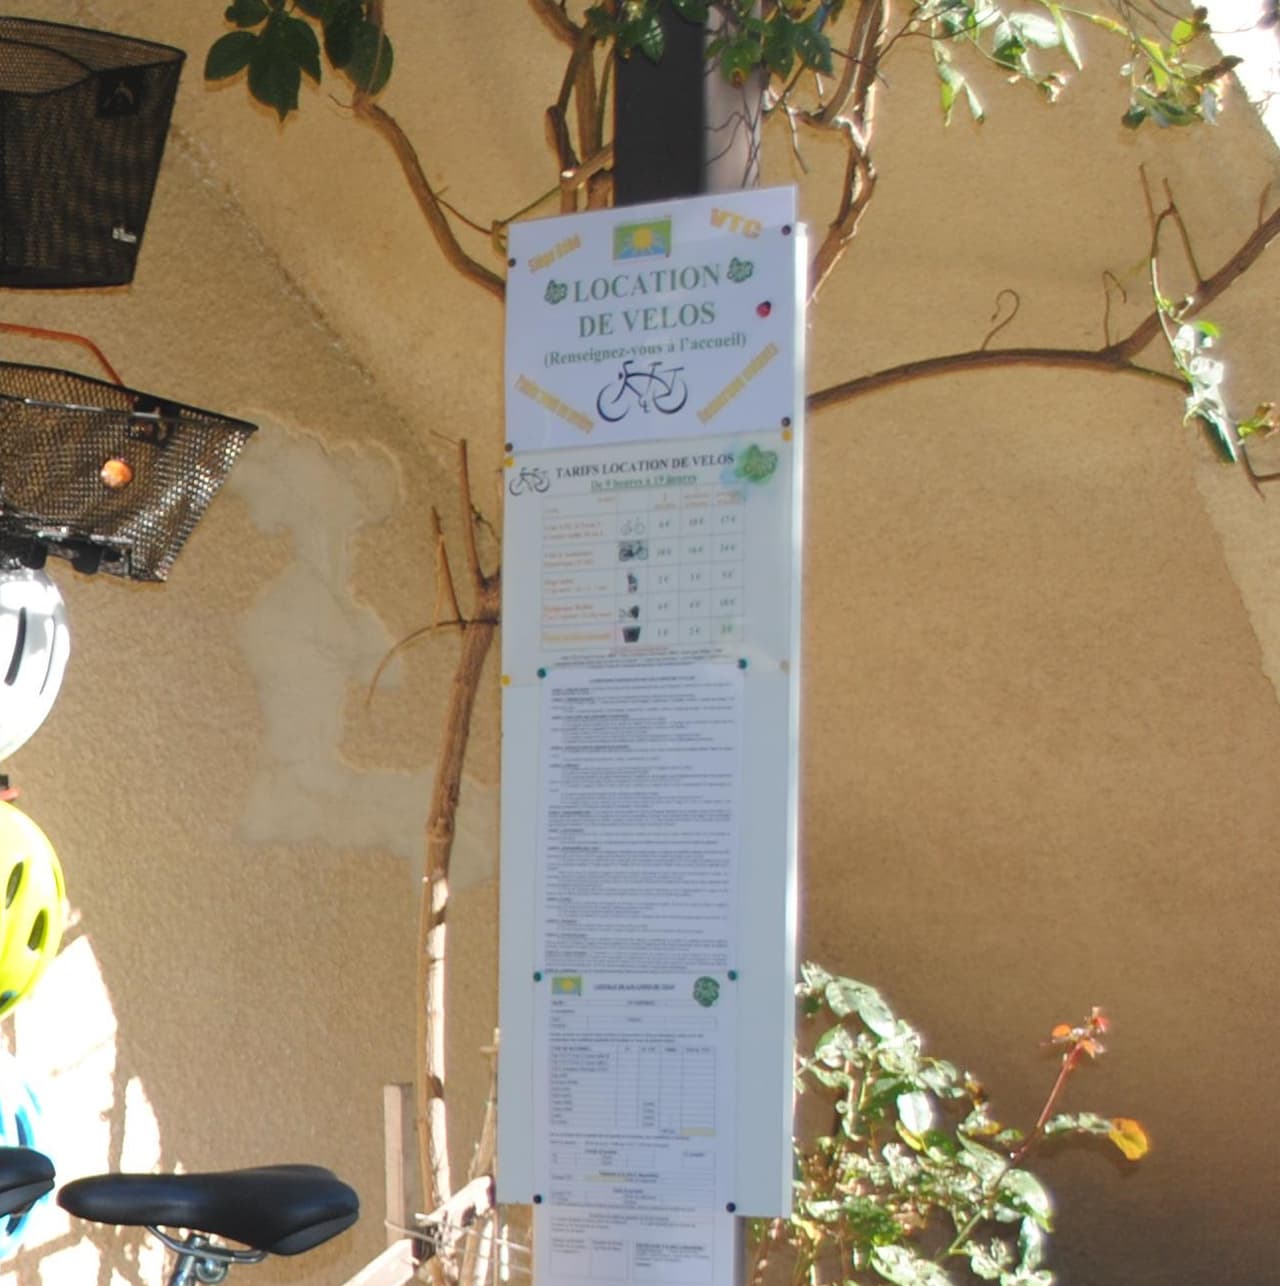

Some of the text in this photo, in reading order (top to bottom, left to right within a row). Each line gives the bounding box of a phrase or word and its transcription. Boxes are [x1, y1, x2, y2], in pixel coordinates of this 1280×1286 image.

[573, 263, 720, 303] LOCATION
[578, 302, 716, 338] DE VELOS
[543, 341, 664, 368] (Renseignez-vous
[680, 331, 747, 352] l'accueil)
[555, 452, 735, 479] TARIFS LOCATION DE VELOS
